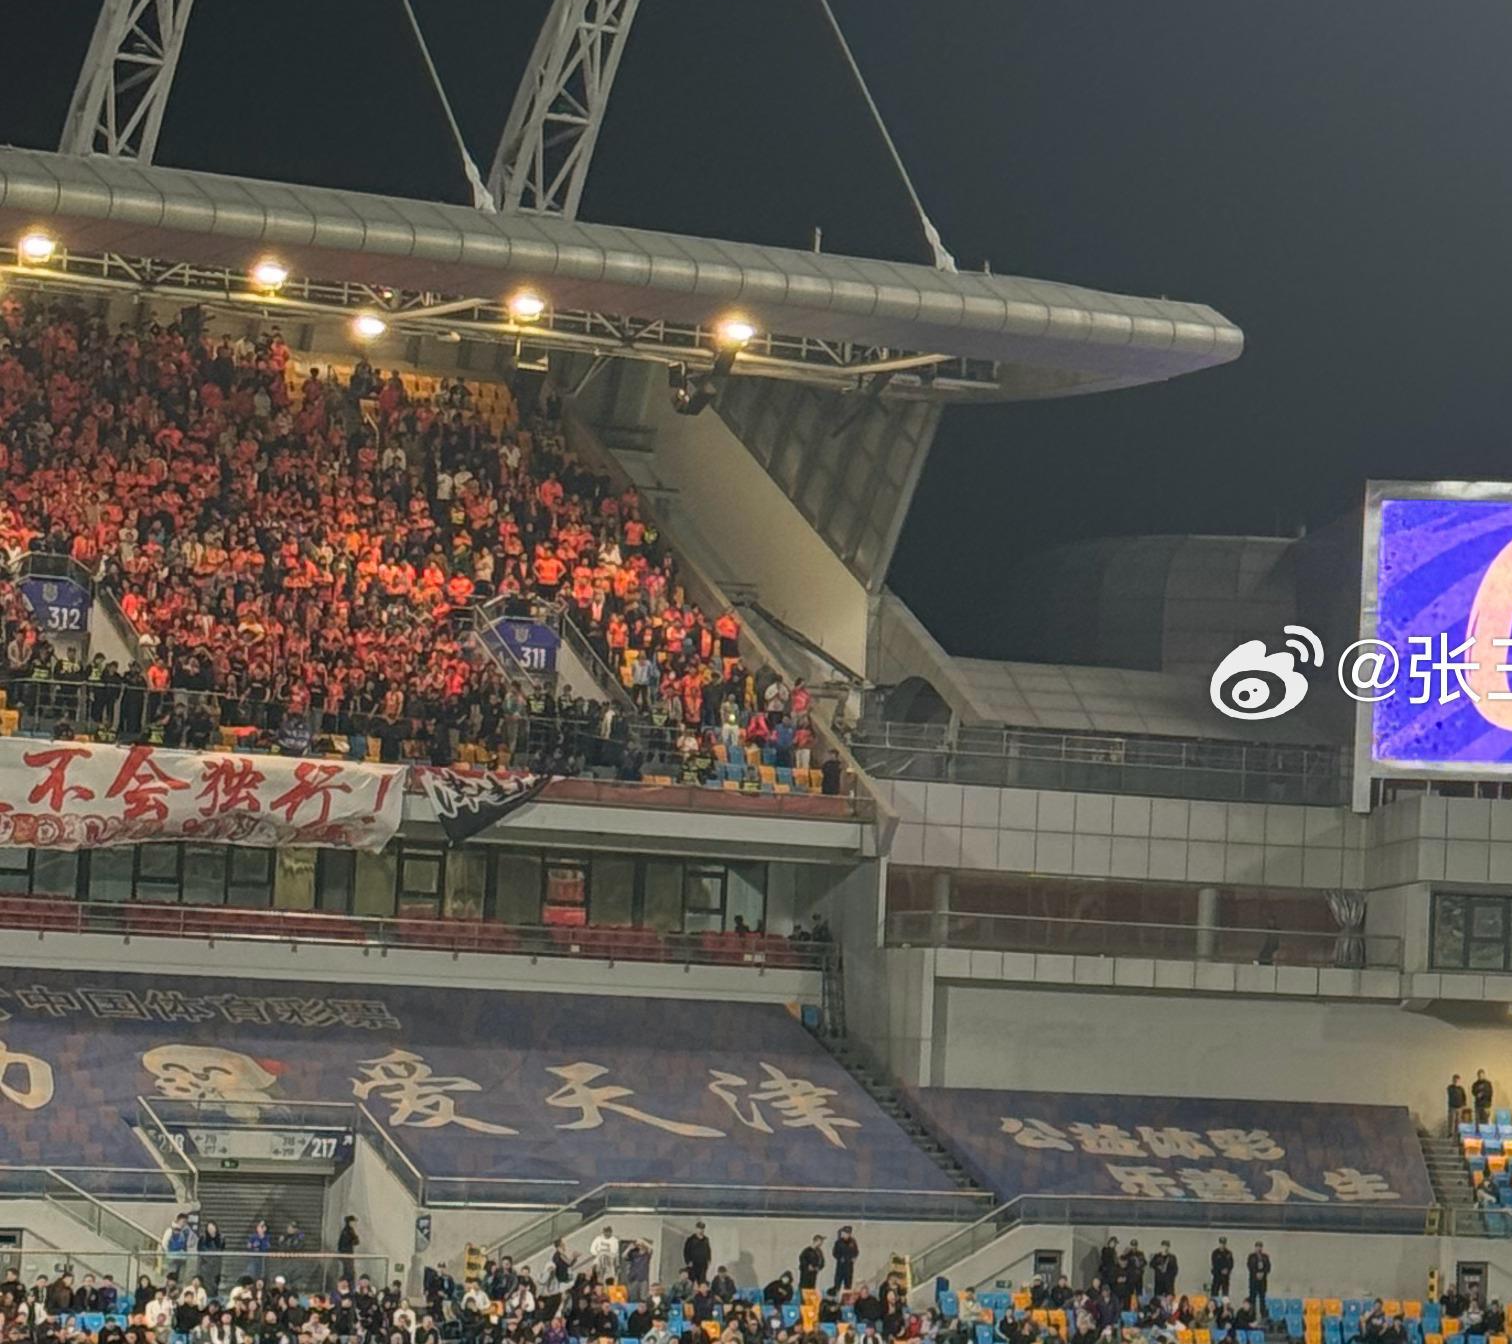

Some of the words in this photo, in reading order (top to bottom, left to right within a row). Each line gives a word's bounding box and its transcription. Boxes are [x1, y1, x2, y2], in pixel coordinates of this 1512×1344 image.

[47, 606, 80, 630] 312
[520, 646, 546, 668] 311
[0, 744, 391, 826] 不会独行！
[352, 1048, 863, 1150] 爱天津
[312, 1137, 338, 1159] 217
